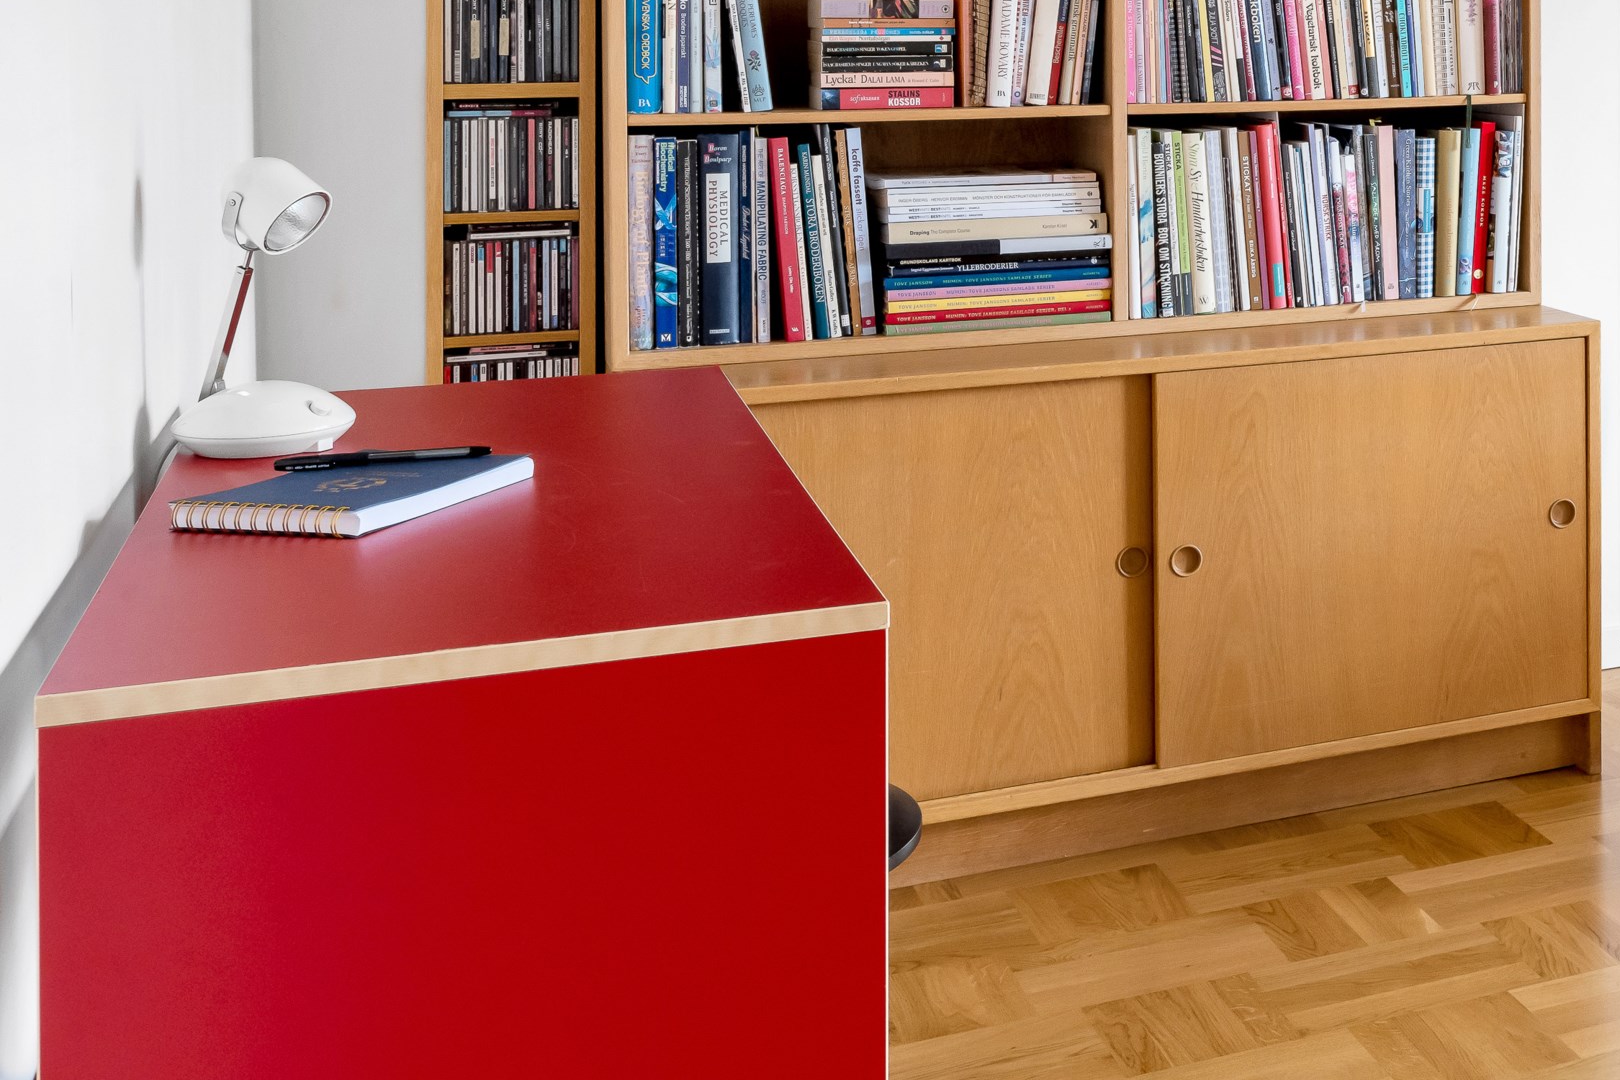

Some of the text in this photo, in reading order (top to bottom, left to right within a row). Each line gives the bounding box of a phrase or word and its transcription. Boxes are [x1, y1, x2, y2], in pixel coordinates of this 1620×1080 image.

[641, 33, 650, 70] ORDBOK
[997, 41, 1009, 79] BOVARY
[825, 74, 857, 84] Lycka!
[861, 75, 883, 83] DALAI
[888, 90, 920, 98] STALINS
[888, 97, 921, 106] KOSSOR
[658, 142, 668, 192] Biochemistry
[777, 148, 787, 195] BALENCIAGA
[1153, 153, 1166, 196] BONNIERS
[1174, 142, 1182, 170] STICKA
[1242, 155, 1251, 192] STICKAT
[708, 180, 718, 257] PHYSIOLOGY
[719, 190, 728, 246] MEDICAL
[805, 198, 816, 228] STORA
[1156, 197, 1168, 224] STORA
[757, 181, 767, 281] MANIPULATING FABRIC
[1158, 227, 1169, 245] BOK
[1191, 191, 1207, 272] Handarbetsboken
[956, 262, 1019, 272] YLLEBRODERIER
[1159, 247, 1170, 261] OM
